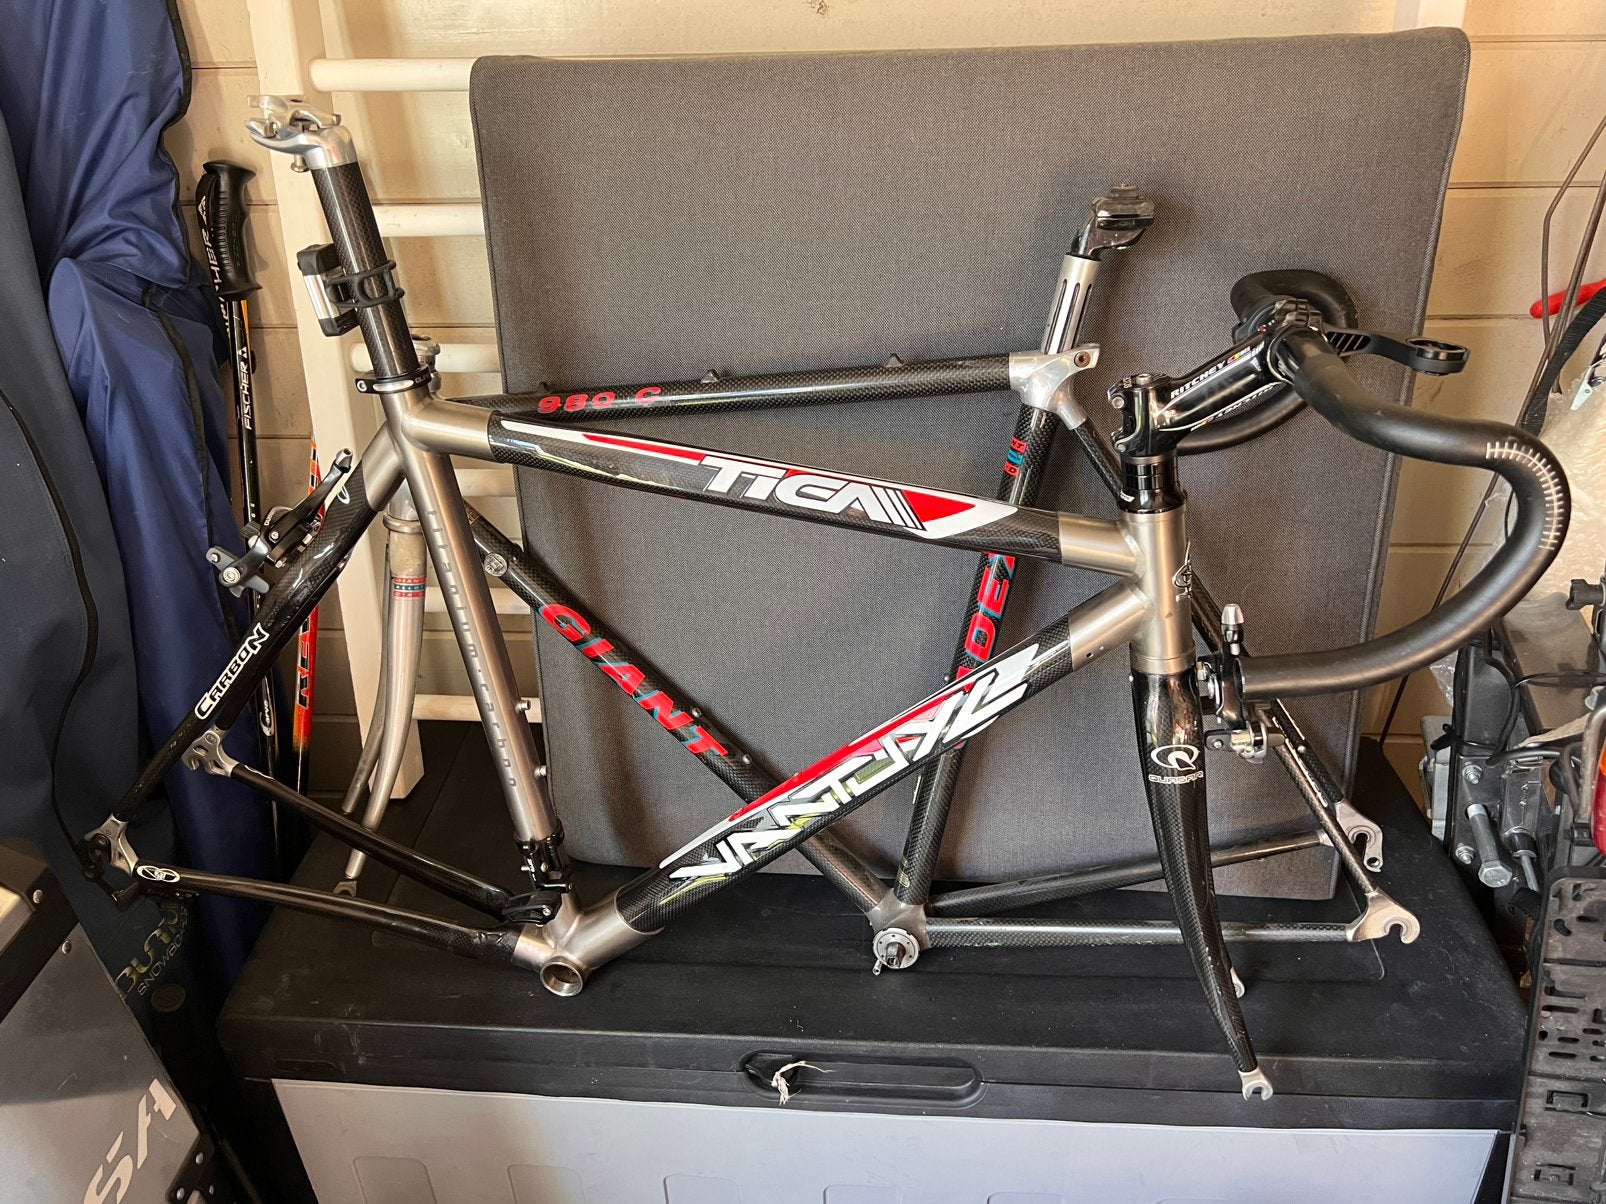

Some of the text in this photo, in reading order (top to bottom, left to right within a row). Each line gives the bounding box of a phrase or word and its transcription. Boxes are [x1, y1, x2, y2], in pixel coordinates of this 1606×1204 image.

[240, 361, 253, 430] FISCHER
[537, 386, 661, 414] 980 C
[1170, 360, 1227, 400] RITCHEY
[194, 622, 270, 720] CARBON
[538, 603, 729, 757] GIANT
[1148, 770, 1204, 785] QUASAR
